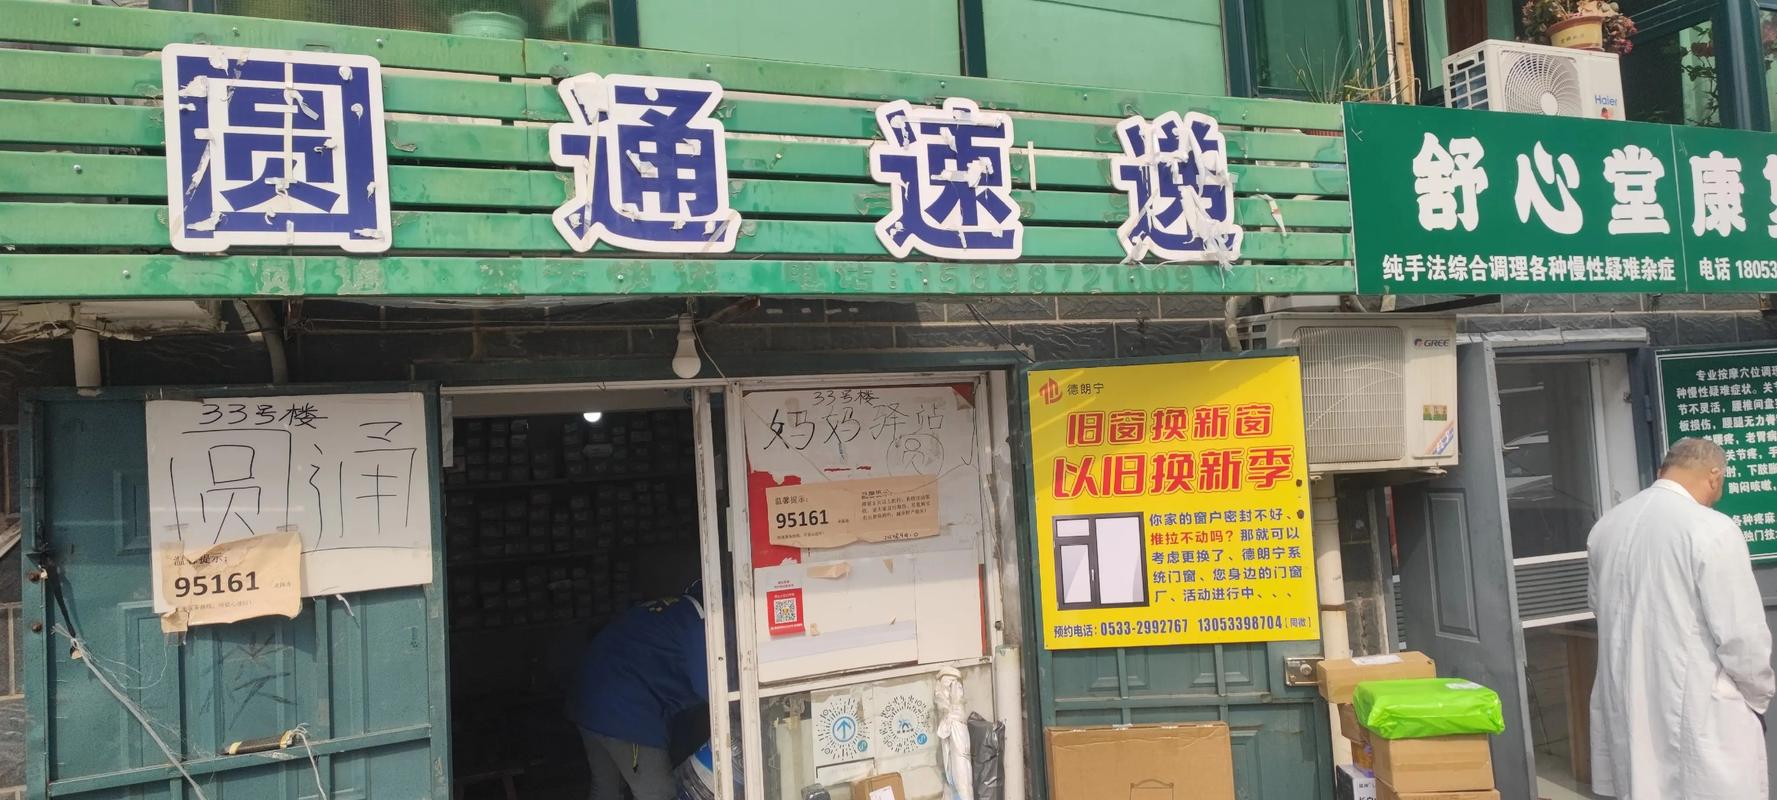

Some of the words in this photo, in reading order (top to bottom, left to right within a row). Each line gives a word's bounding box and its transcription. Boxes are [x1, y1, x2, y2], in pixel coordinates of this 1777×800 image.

[1594, 94, 1618, 106] Haier
[1412, 132, 1777, 240] 舒心堂康
[1382, 253, 1676, 284] 纯手法综合调理各种慢性疑难杂症
[1698, 256, 1732, 281] 电话
[1423, 339, 1449, 347] GREE
[812, 388, 880, 408] 33号楼
[1067, 383, 1104, 396] 德朗宁
[199, 402, 329, 428] 33号楼
[1678, 398, 1777, 416] 节不灵活，腰椎间盘
[1067, 403, 1272, 446] 旧窗换新窗
[1052, 447, 1294, 499] 以旧换新季
[776, 509, 829, 529] 95161
[1744, 528, 1777, 543] 独门技
[1151, 546, 1301, 565] 考虑更换了、德朗宁系
[174, 571, 260, 598] 95161
[1153, 565, 1303, 584] 统门窗、您身边的门窗
